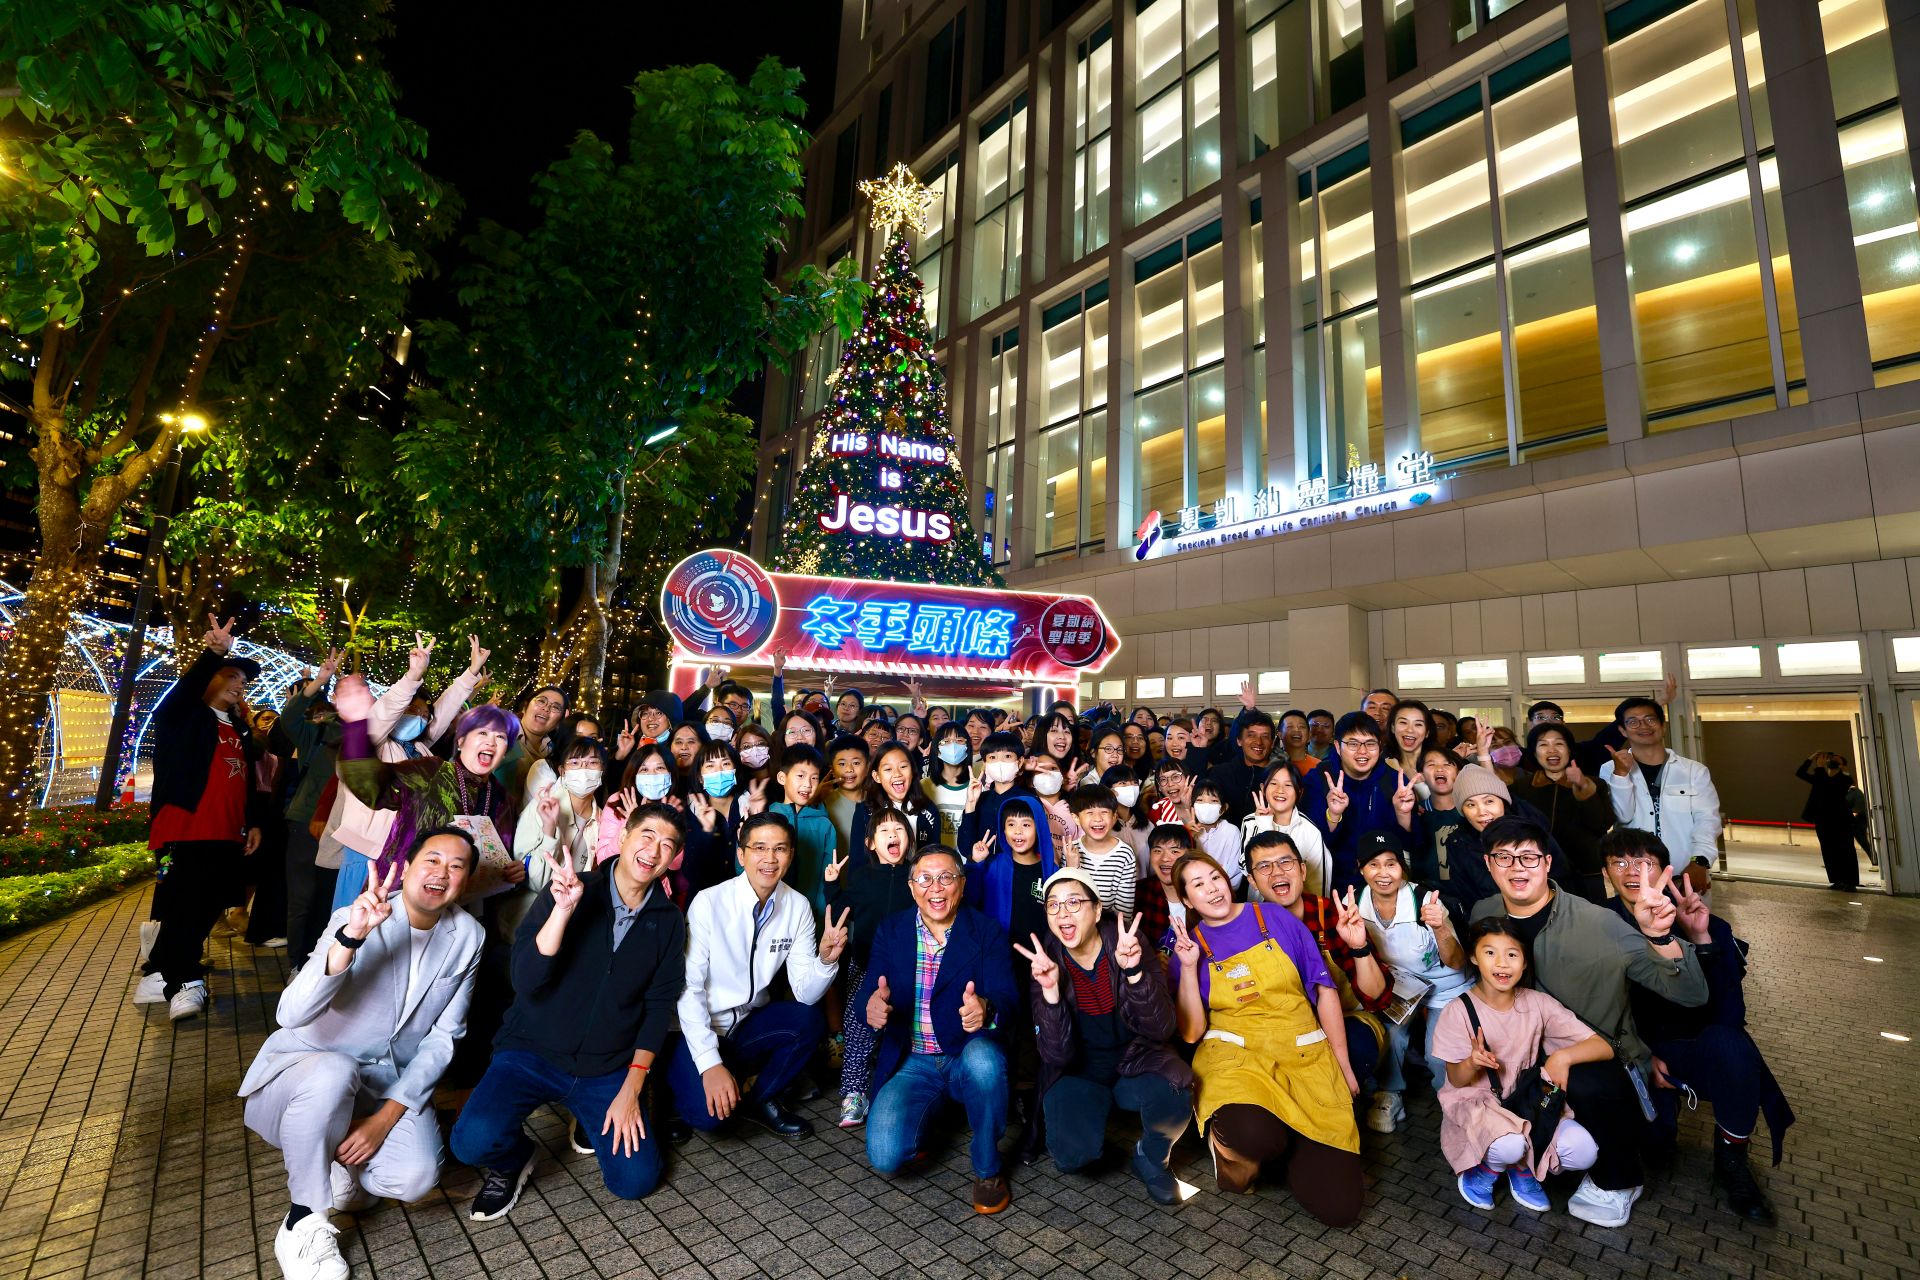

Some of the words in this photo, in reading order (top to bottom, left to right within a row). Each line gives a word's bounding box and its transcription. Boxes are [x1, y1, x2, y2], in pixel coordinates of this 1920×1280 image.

[831, 432, 868, 453] His
[880, 434, 946, 462] Name
[881, 466, 902, 488] is
[1176, 450, 1434, 535] 夏凱納靈糧堂
[820, 494, 951, 541] Jesus
[1220, 528, 1249, 543] Bread
[1254, 524, 1266, 536] of
[1271, 520, 1294, 534] Life
[1299, 508, 1347, 528] Christian
[1354, 499, 1398, 517] Church
[801, 595, 1016, 658] 冬季頭條
[1047, 630, 1092, 645] 聖誕季
[1052, 613, 1095, 629] 夏凱納
